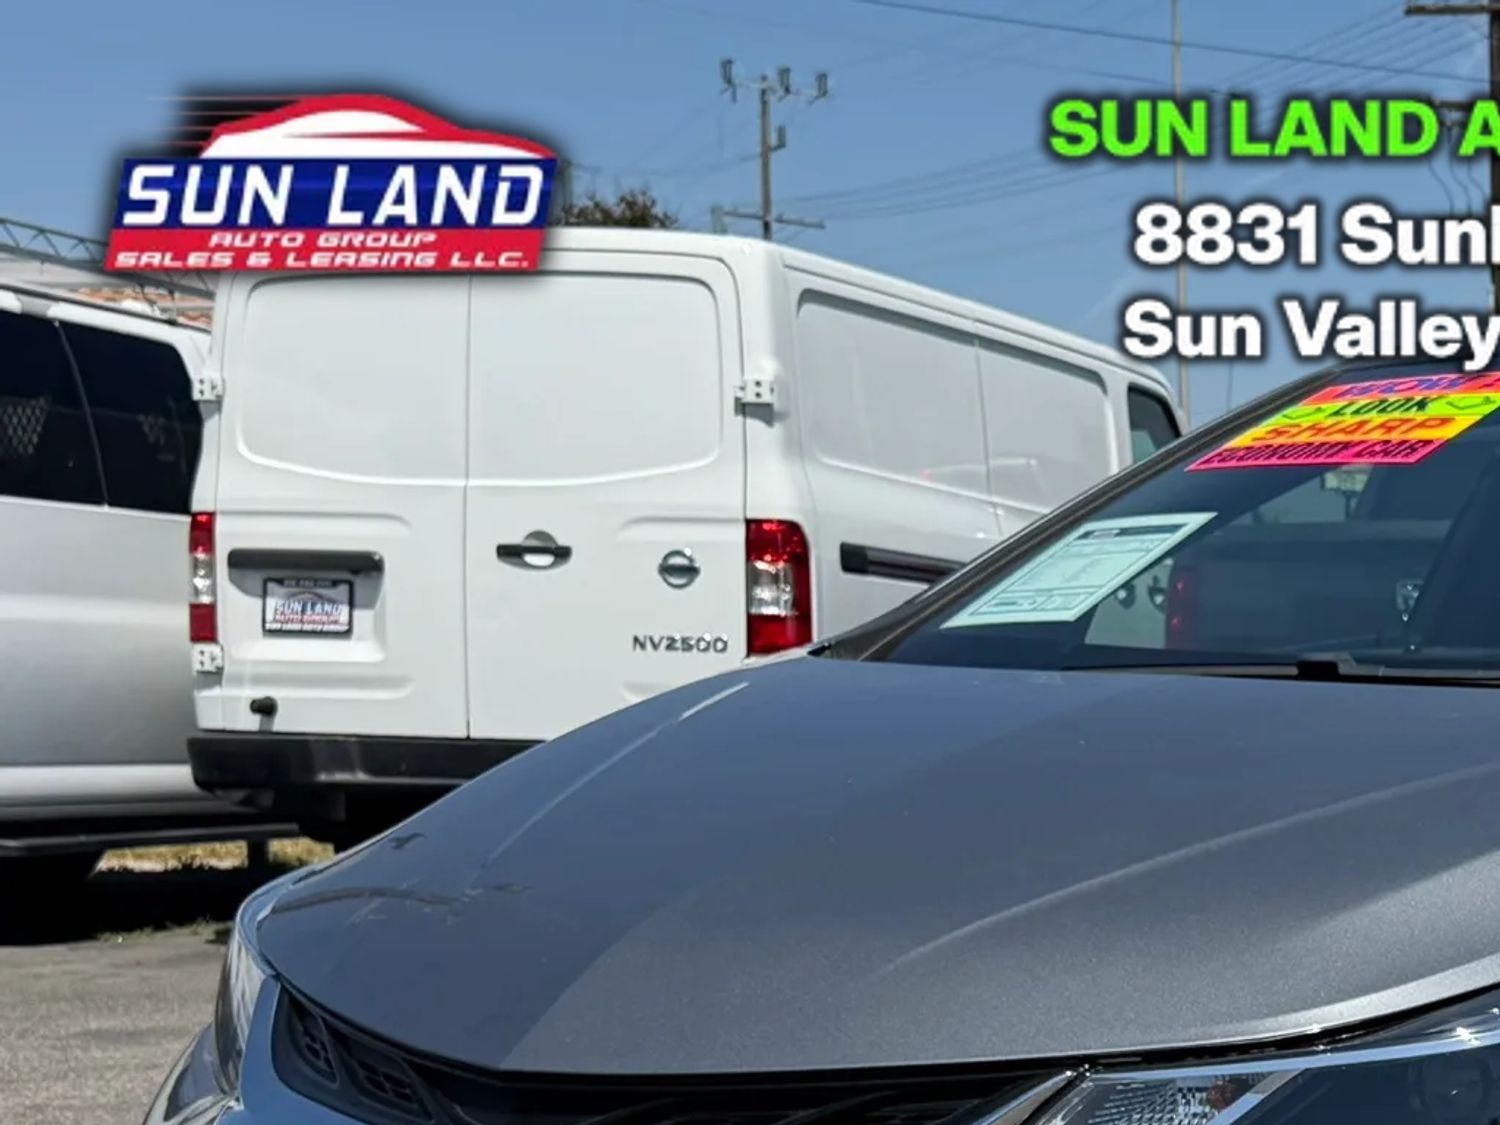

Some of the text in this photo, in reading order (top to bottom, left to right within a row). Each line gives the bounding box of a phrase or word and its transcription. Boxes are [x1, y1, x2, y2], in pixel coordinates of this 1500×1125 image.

[1322, 395, 1447, 418] LOOK
[1251, 417, 1457, 443] SHARP
[1357, 440, 1437, 463] CAR
[633, 634, 728, 653] NV2500
